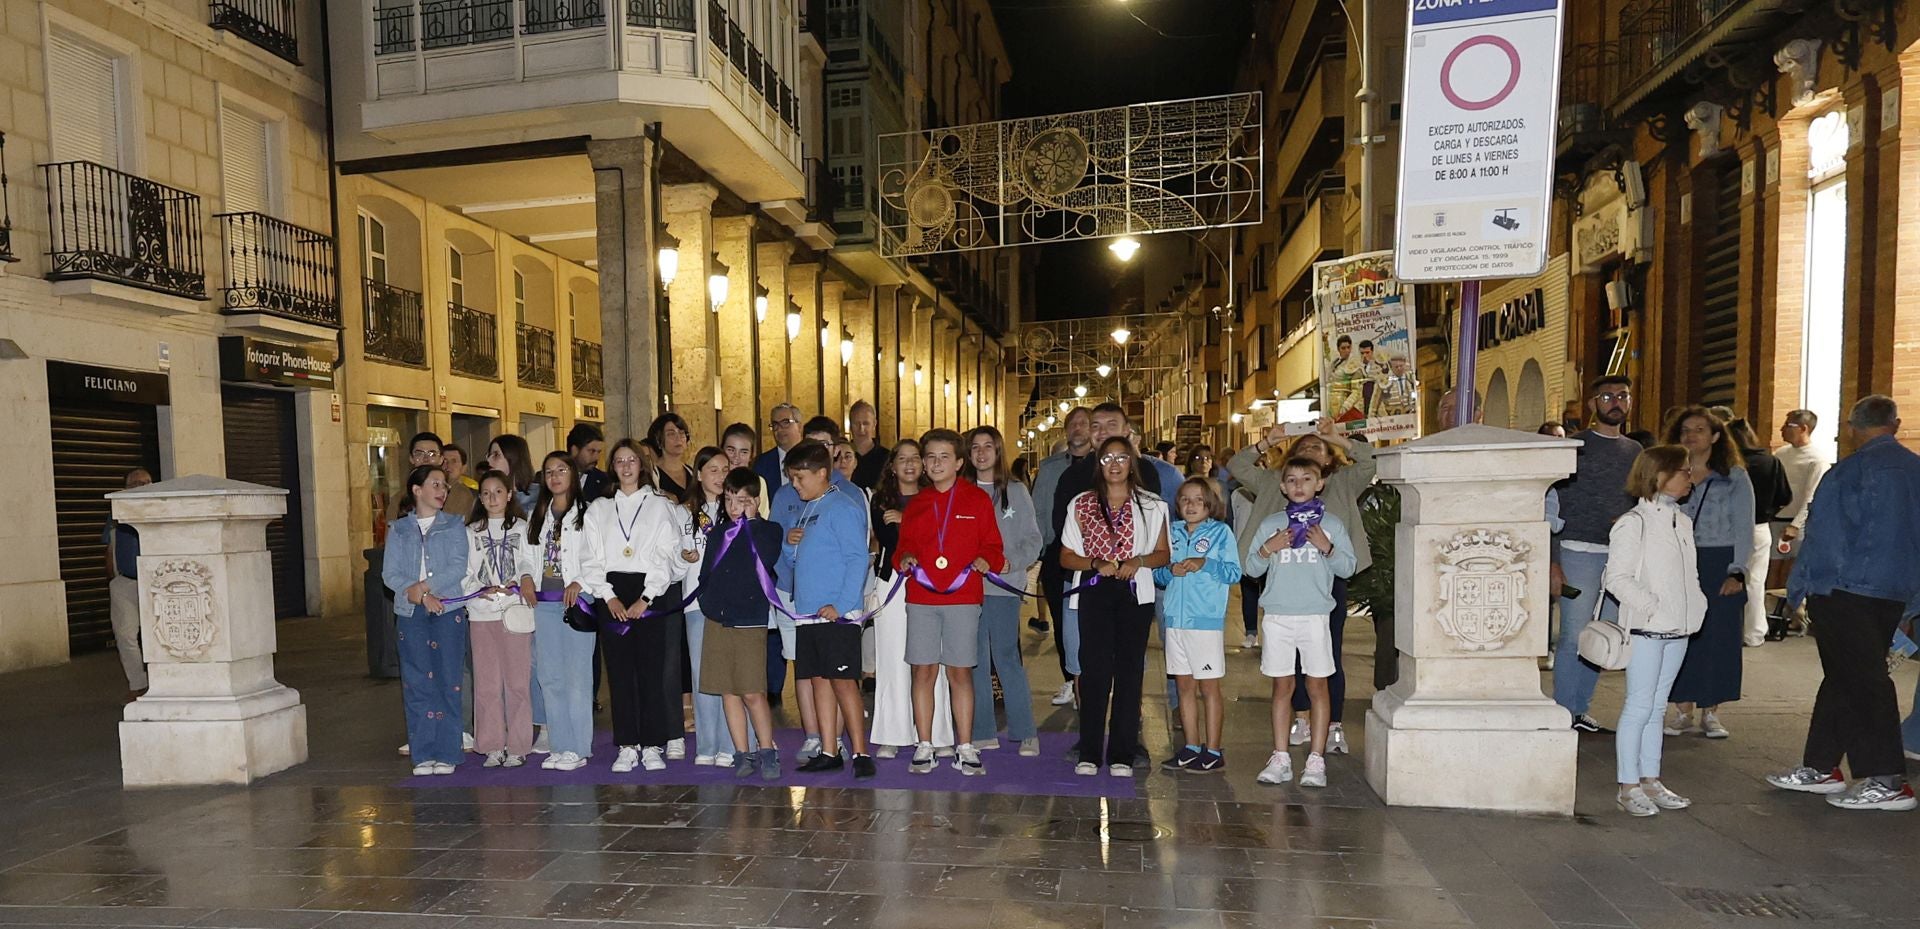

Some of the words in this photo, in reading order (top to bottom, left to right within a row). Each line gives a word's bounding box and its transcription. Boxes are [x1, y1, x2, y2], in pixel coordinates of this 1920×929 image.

[1428, 123, 1465, 136] EXCEPTO
[1467, 118, 1526, 133] AUTORIZADOS,
[1434, 139, 1462, 151] CARGA
[1465, 138, 1471, 148] Y
[1473, 134, 1518, 147] DESCARGA
[1432, 155, 1443, 166] DE
[1445, 153, 1472, 165] LUNES
[1475, 152, 1481, 162] A
[1484, 149, 1519, 161] VIERNES
[1435, 170, 1446, 181] DE
[1449, 168, 1468, 180] 8:00
[1470, 168, 1477, 178] A
[1480, 165, 1500, 177] 11:00
[1502, 165, 1509, 175] H
[1430, 246, 1467, 254] VIGILANCIA
[1500, 288, 1545, 341] CASA
[247, 347, 280, 367] fotoprix
[85, 376, 137, 393] FELICIANO
[1280, 548, 1318, 564] BYE
